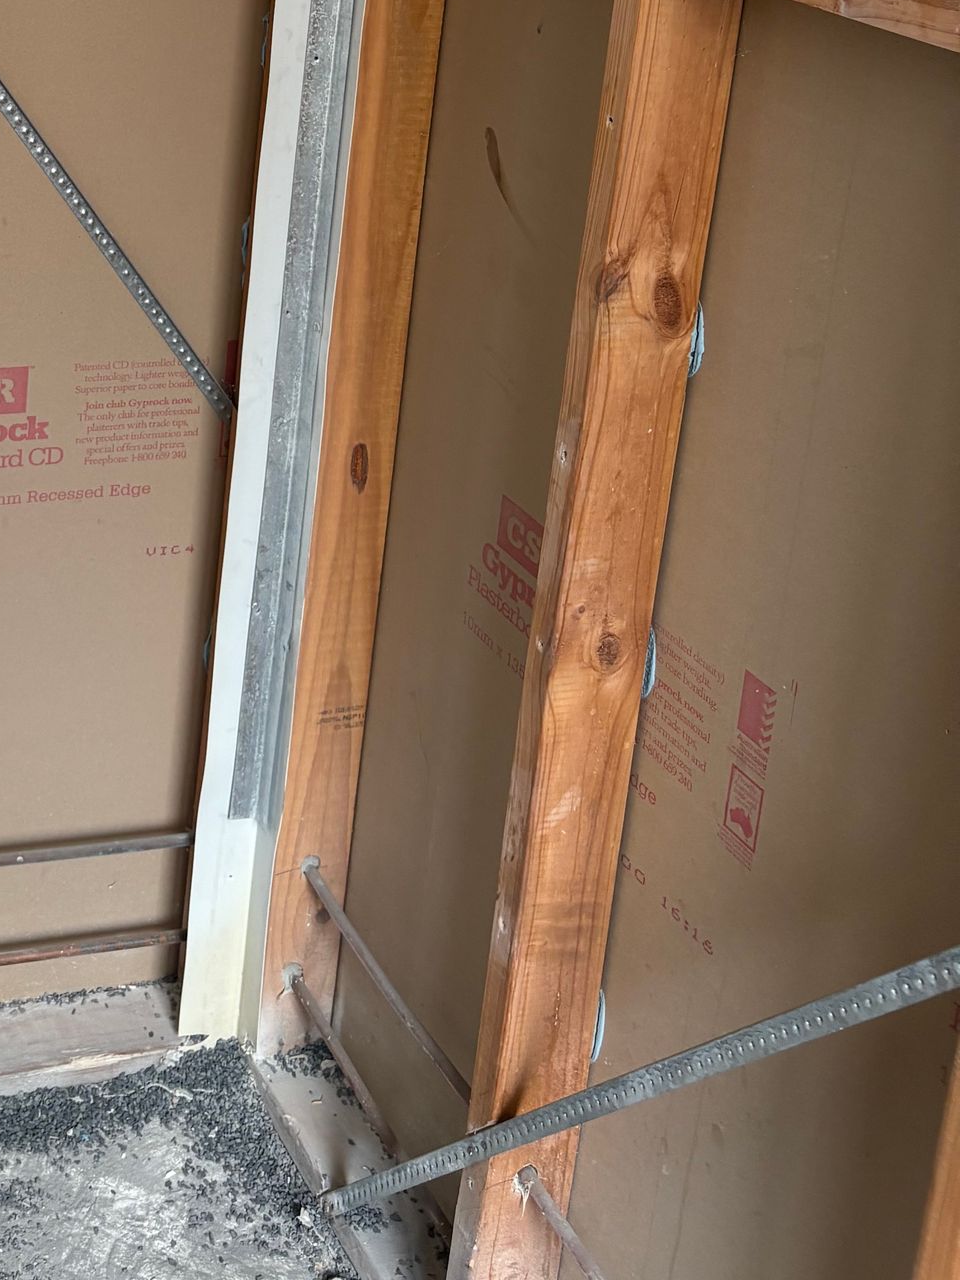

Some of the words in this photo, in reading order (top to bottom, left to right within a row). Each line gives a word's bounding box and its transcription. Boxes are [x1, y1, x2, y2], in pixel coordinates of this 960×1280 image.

[112, 360, 129, 369] CD
[106, 400, 126, 409] club
[128, 397, 169, 409] Gyprock
[28, 447, 64, 467] CD
[26, 485, 104, 503] Recessed
[109, 483, 151, 498] Edge
